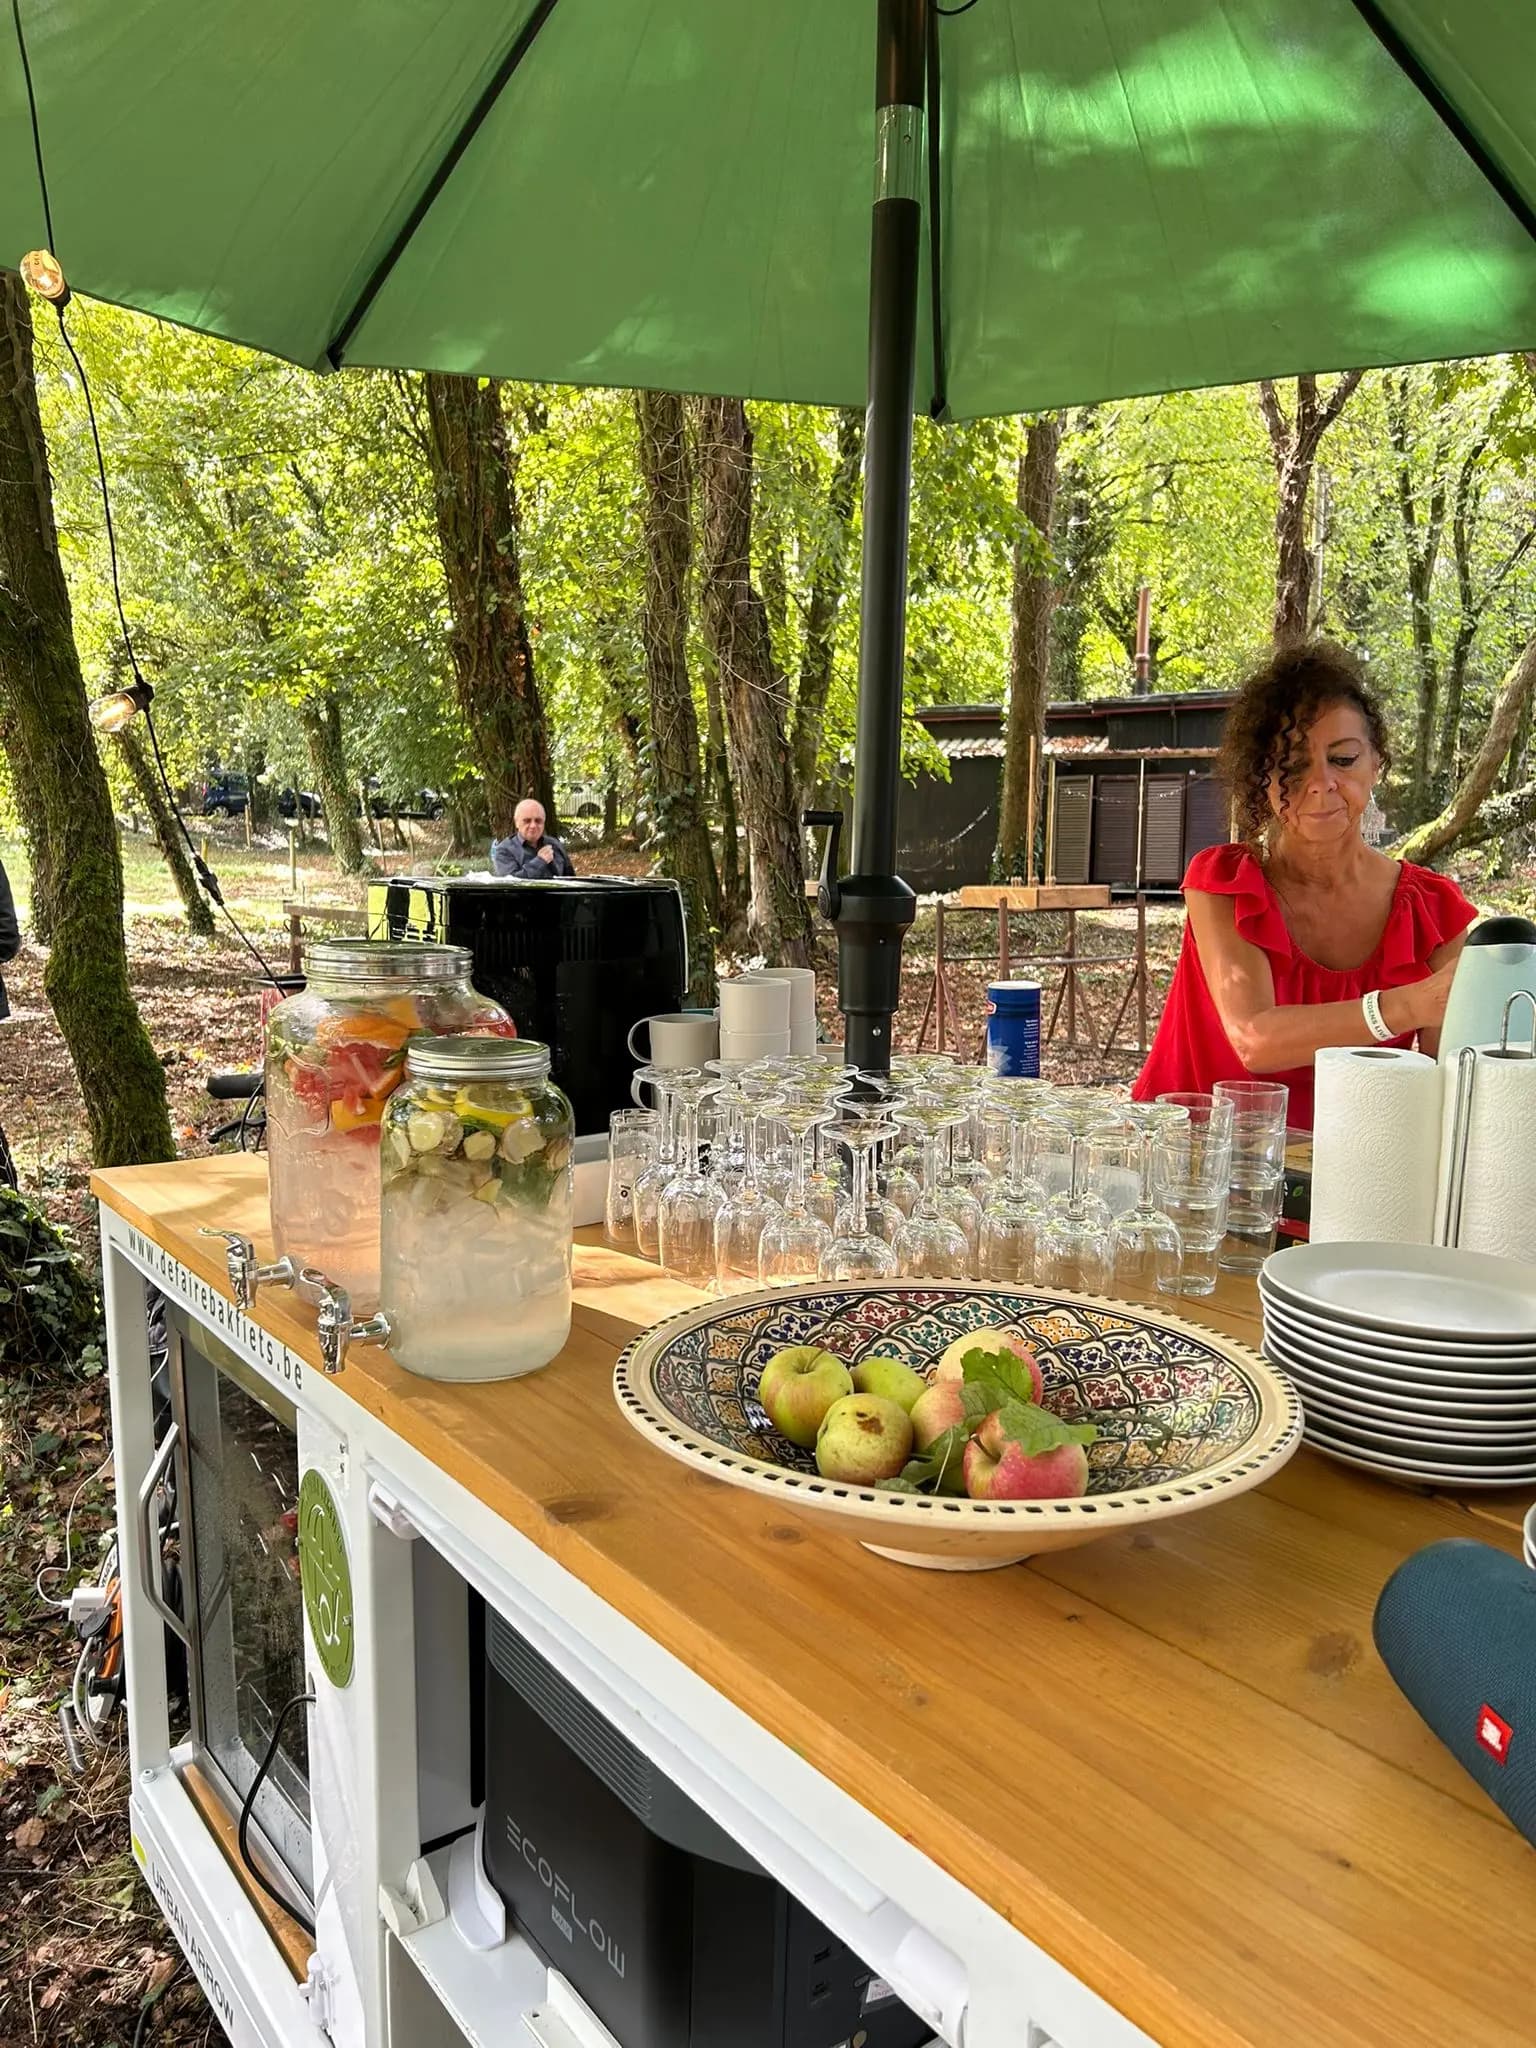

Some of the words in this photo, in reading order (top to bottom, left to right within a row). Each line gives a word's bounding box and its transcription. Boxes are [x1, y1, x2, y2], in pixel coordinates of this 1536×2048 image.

[128, 1229, 303, 1390] www.defairebakfiets.be
[152, 1863, 189, 1944] URBAN
[191, 1937, 234, 2027] ARROW
[506, 1816, 625, 1979] ECOFLOW
